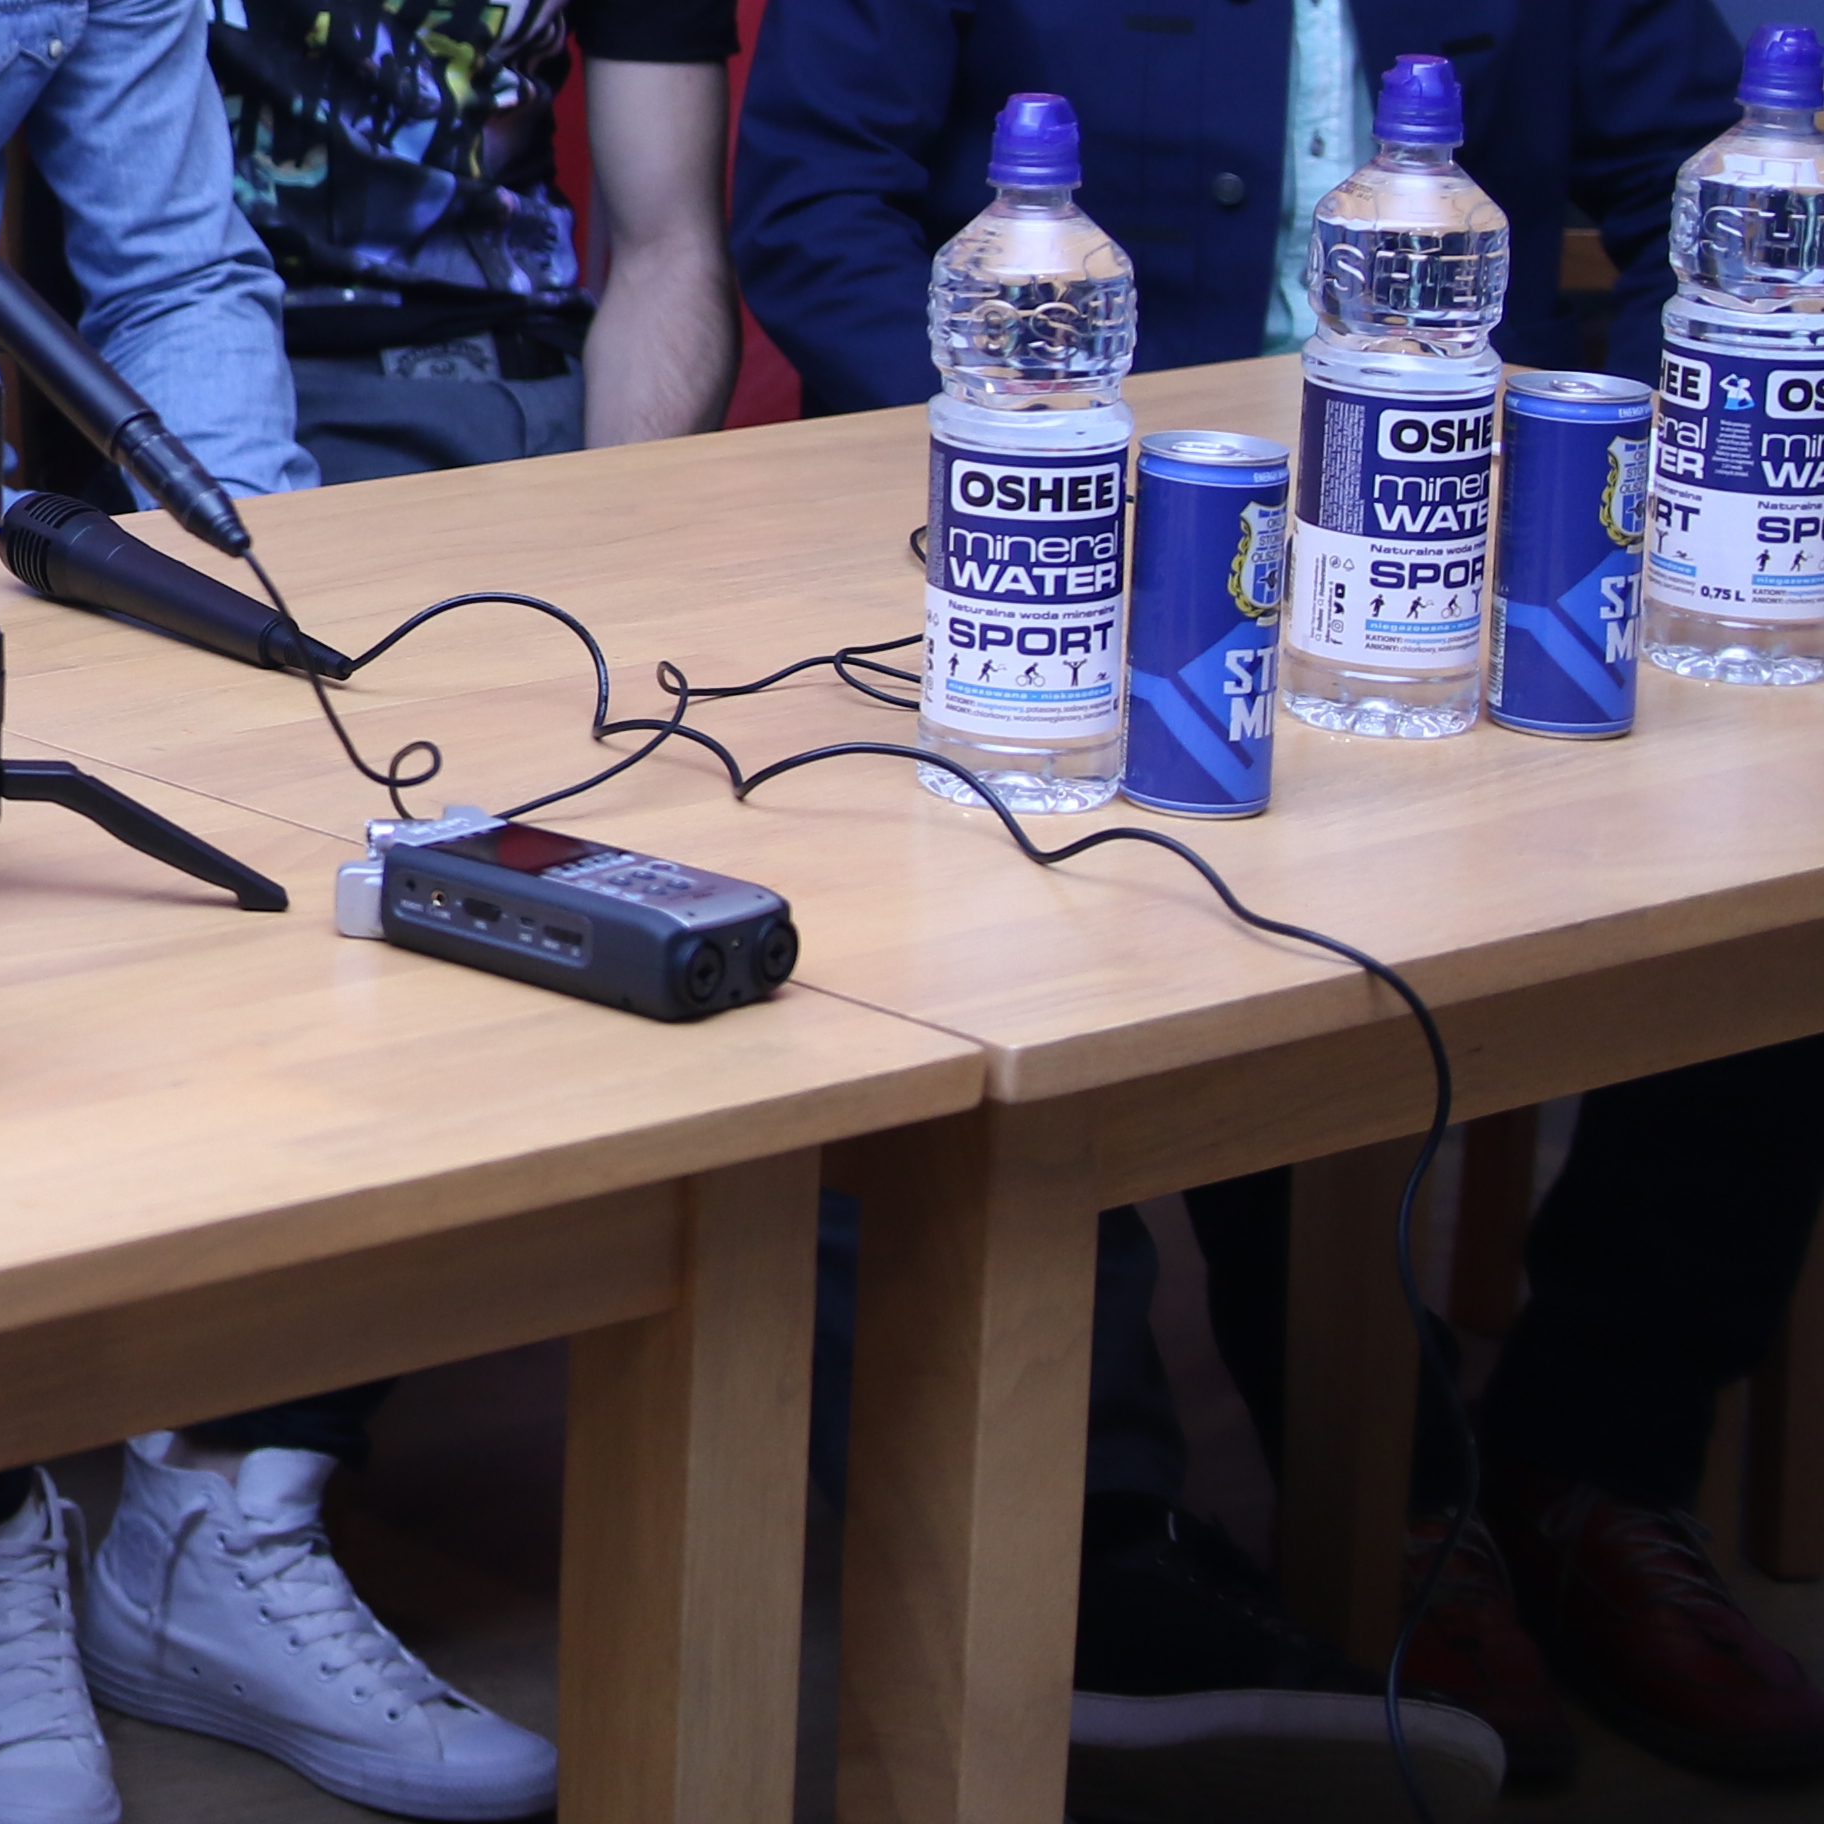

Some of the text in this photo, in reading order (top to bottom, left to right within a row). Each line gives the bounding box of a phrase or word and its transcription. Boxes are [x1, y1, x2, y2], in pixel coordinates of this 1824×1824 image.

[959, 471, 1116, 513] OSHEE
[948, 520, 1118, 563] mineral
[1370, 543, 1443, 556] Naturalna
[948, 556, 1117, 596] WATER
[1701, 586, 1745, 602] 0,75 L
[948, 599, 1059, 619] Naturalna woda
[948, 617, 1114, 656] SPORT
